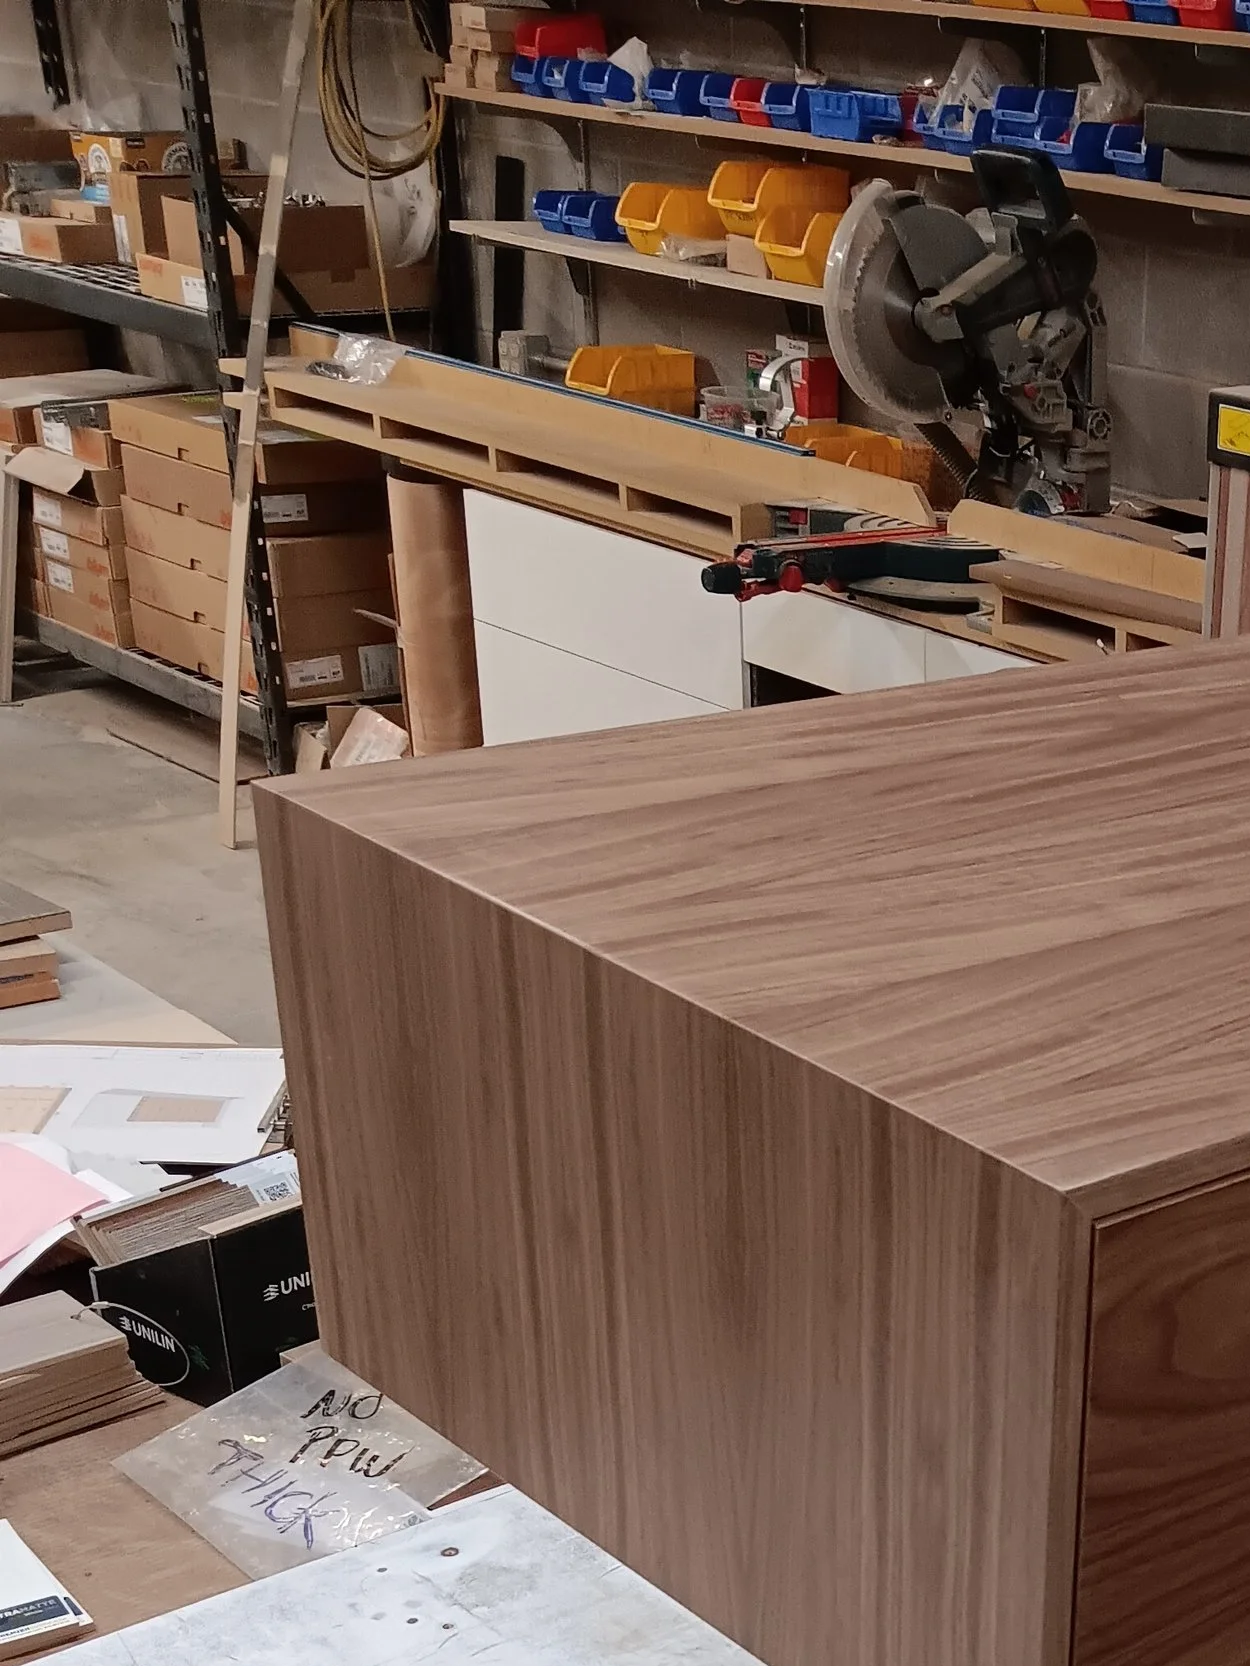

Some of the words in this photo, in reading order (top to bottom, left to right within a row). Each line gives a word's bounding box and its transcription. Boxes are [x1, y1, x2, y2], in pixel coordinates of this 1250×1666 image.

[280, 1271, 312, 1296] UNI
[131, 1320, 176, 1353] UNILIN
[300, 1389, 384, 1420] NO
